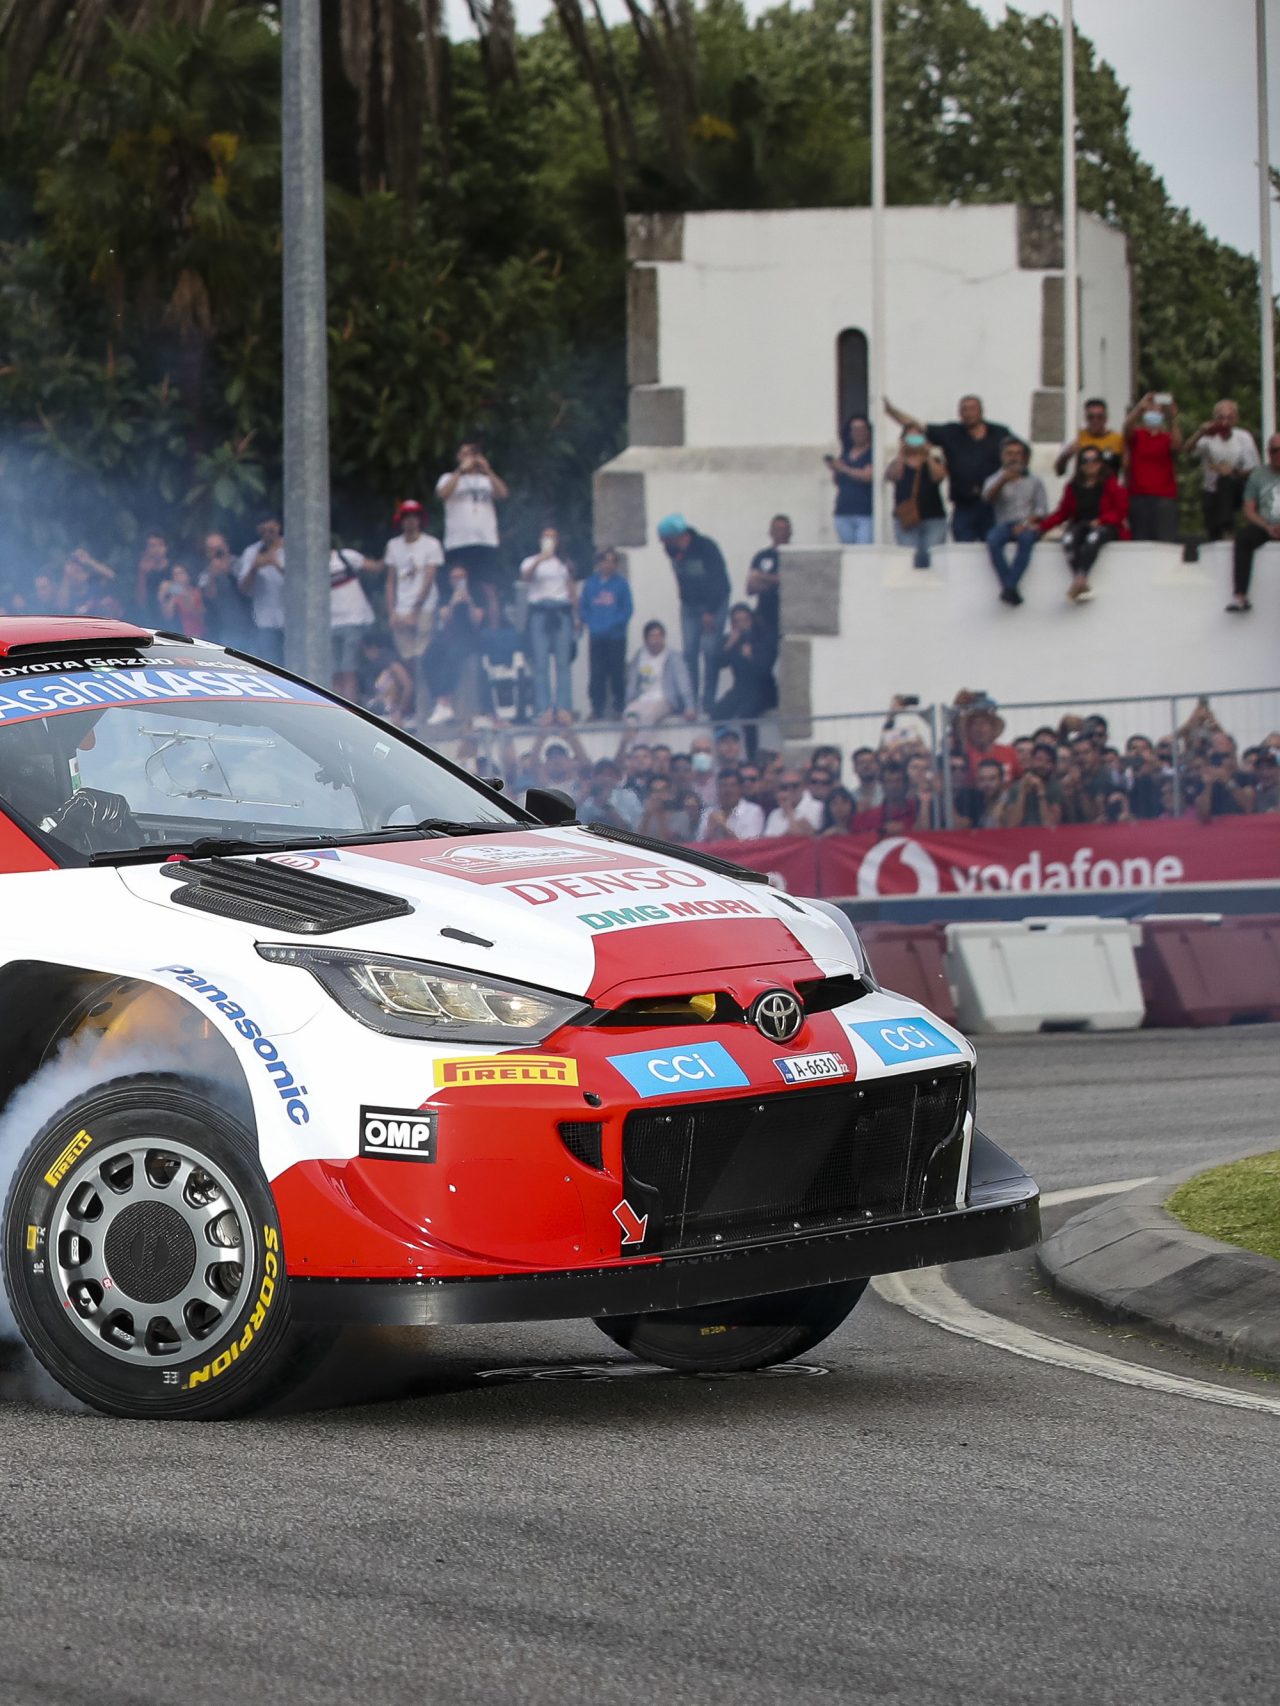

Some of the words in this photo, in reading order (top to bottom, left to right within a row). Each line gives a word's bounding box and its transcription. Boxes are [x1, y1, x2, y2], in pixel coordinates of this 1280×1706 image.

[88, 656, 174, 669] GAZOO
[176, 657, 258, 674] Racing
[951, 848, 1184, 893] vodafone
[501, 870, 706, 905] DENSO
[576, 905, 670, 930] DMG
[661, 899, 762, 917] MORI
[152, 964, 310, 1126] Panasonic
[443, 1057, 567, 1084] PIRELLI
[794, 1058, 838, 1078] A-6630
[363, 1119, 430, 1148] OMP
[44, 1129, 94, 1188] PIRELLI
[189, 1224, 279, 1389] SCORPION
